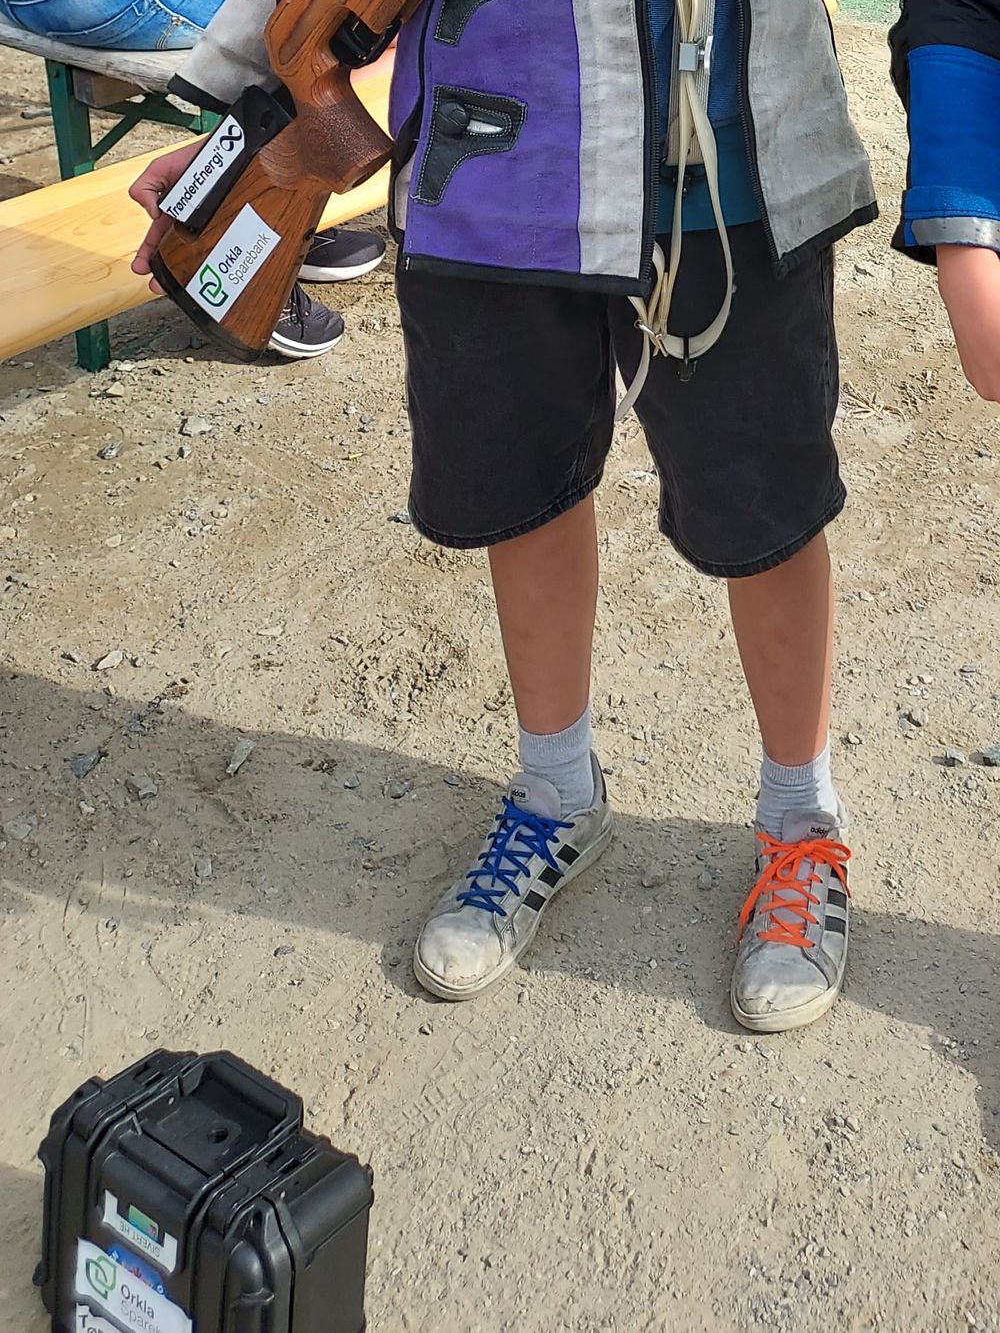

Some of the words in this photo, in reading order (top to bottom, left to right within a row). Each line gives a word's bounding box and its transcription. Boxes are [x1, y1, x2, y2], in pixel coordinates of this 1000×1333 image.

[166, 146, 224, 219] TrønderEnergi
[218, 244, 243, 274] Orkla
[228, 231, 271, 285] Sparebank
[120, 1284, 155, 1319] Orkla
